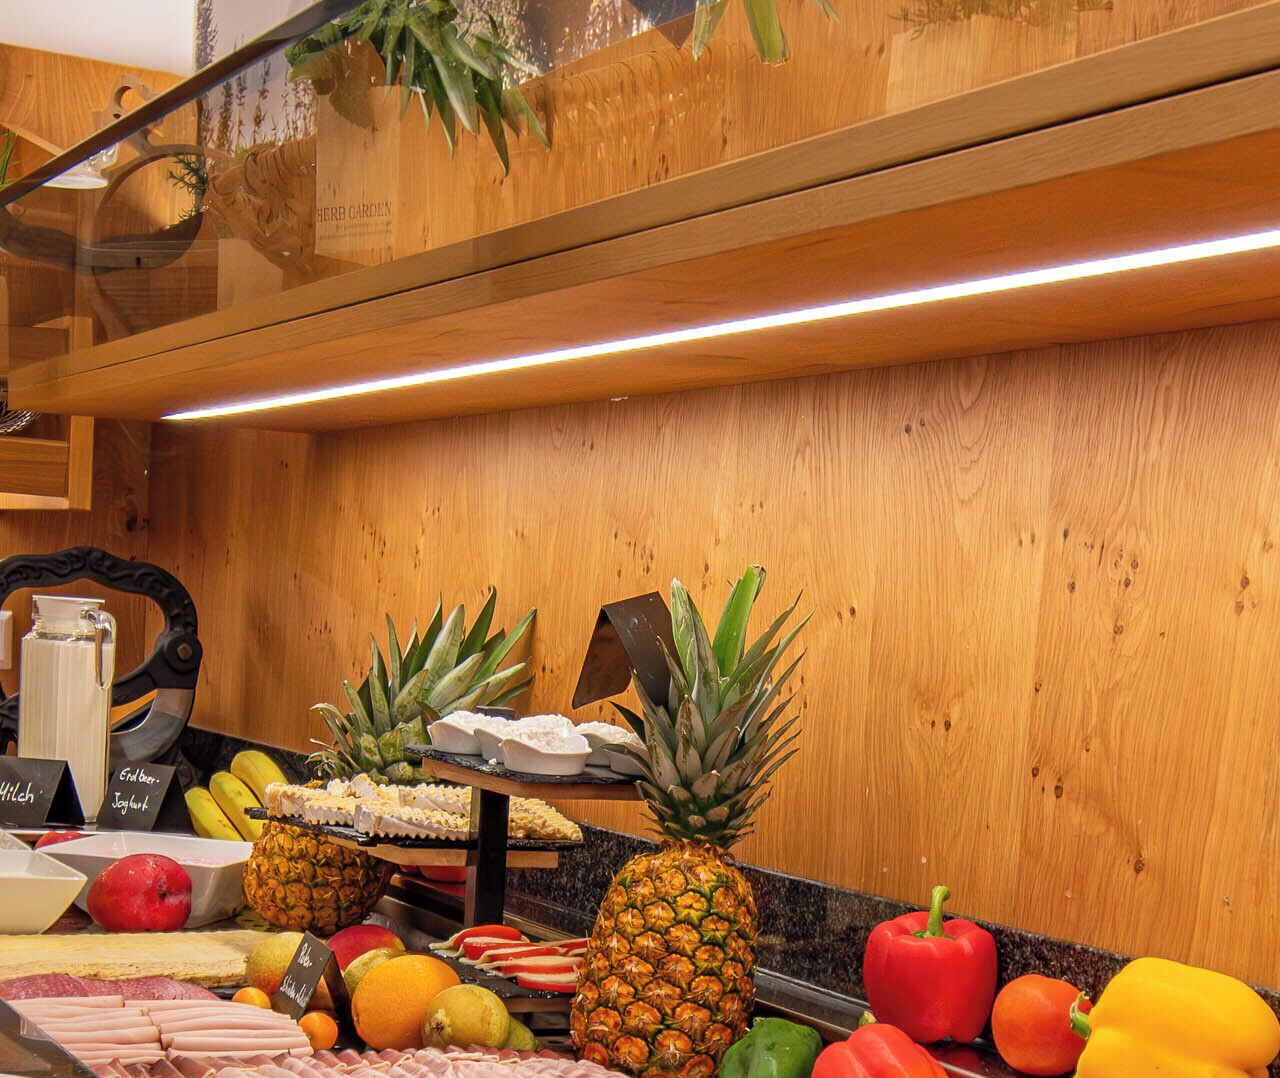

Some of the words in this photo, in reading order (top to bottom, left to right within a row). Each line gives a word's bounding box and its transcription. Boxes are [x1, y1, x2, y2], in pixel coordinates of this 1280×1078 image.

[316, 205, 346, 223] HERB
[348, 201, 392, 220] GARDEN
[111, 791, 149, 816] Joghurt
